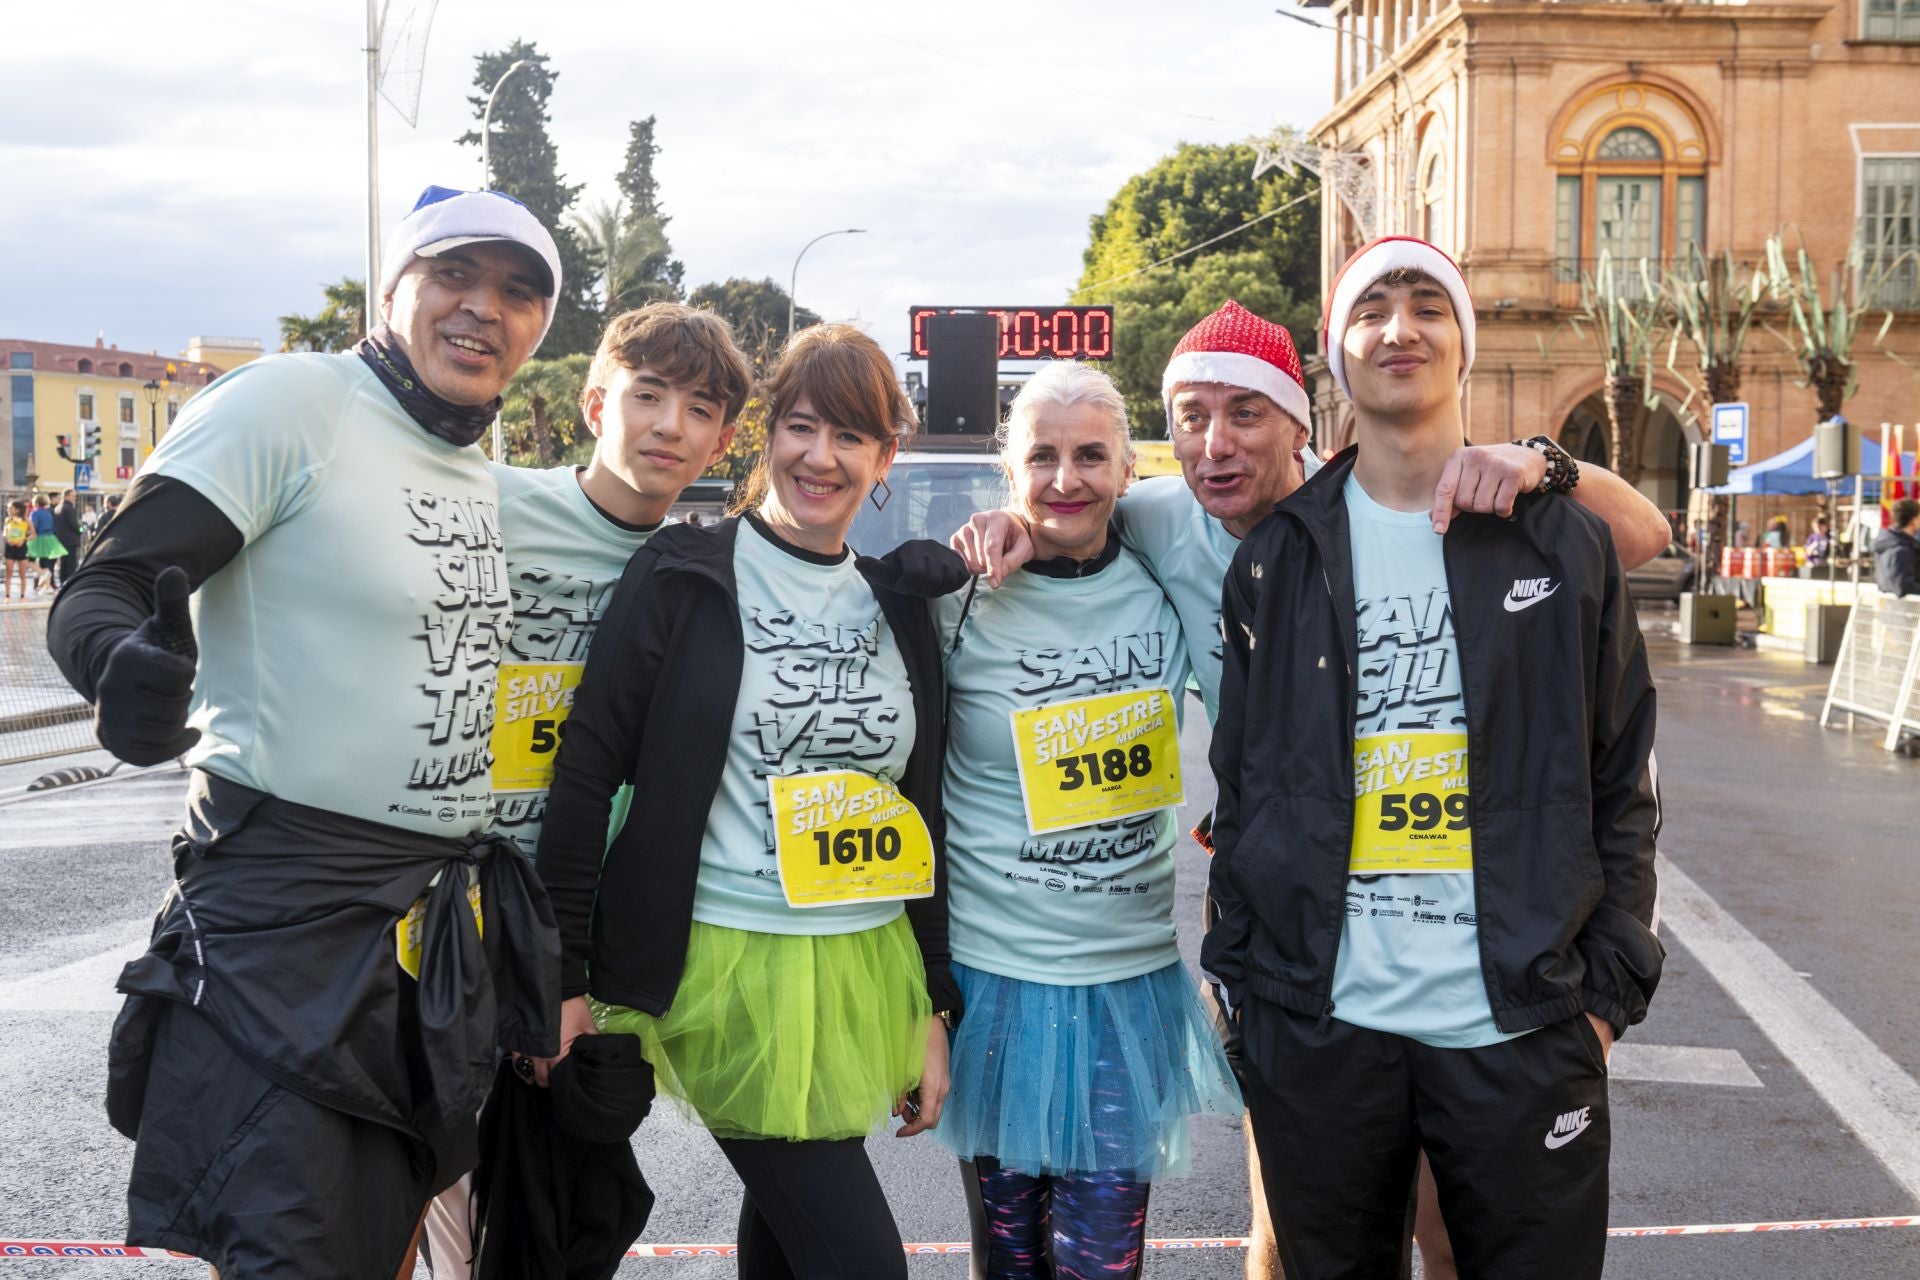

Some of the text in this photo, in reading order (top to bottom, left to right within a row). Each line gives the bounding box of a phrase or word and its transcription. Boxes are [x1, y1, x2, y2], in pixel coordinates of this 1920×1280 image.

[1511, 577, 1551, 599] NIKE
[766, 655, 883, 709] SIL
[1010, 630, 1165, 697] SAN
[506, 672, 563, 701] SAN
[740, 706, 900, 766] VES
[1032, 707, 1087, 743] SAN
[1035, 695, 1164, 766] SILVESTRE
[1115, 719, 1164, 746] MURCIA
[1055, 744, 1153, 792] 3188
[1354, 741, 1411, 775] SAN
[791, 780, 847, 812] SAN
[1378, 792, 1472, 832] 599
[813, 826, 902, 866] 1610
[1020, 822, 1159, 865] MURCIA
[1553, 1105, 1591, 1134] NIKE
